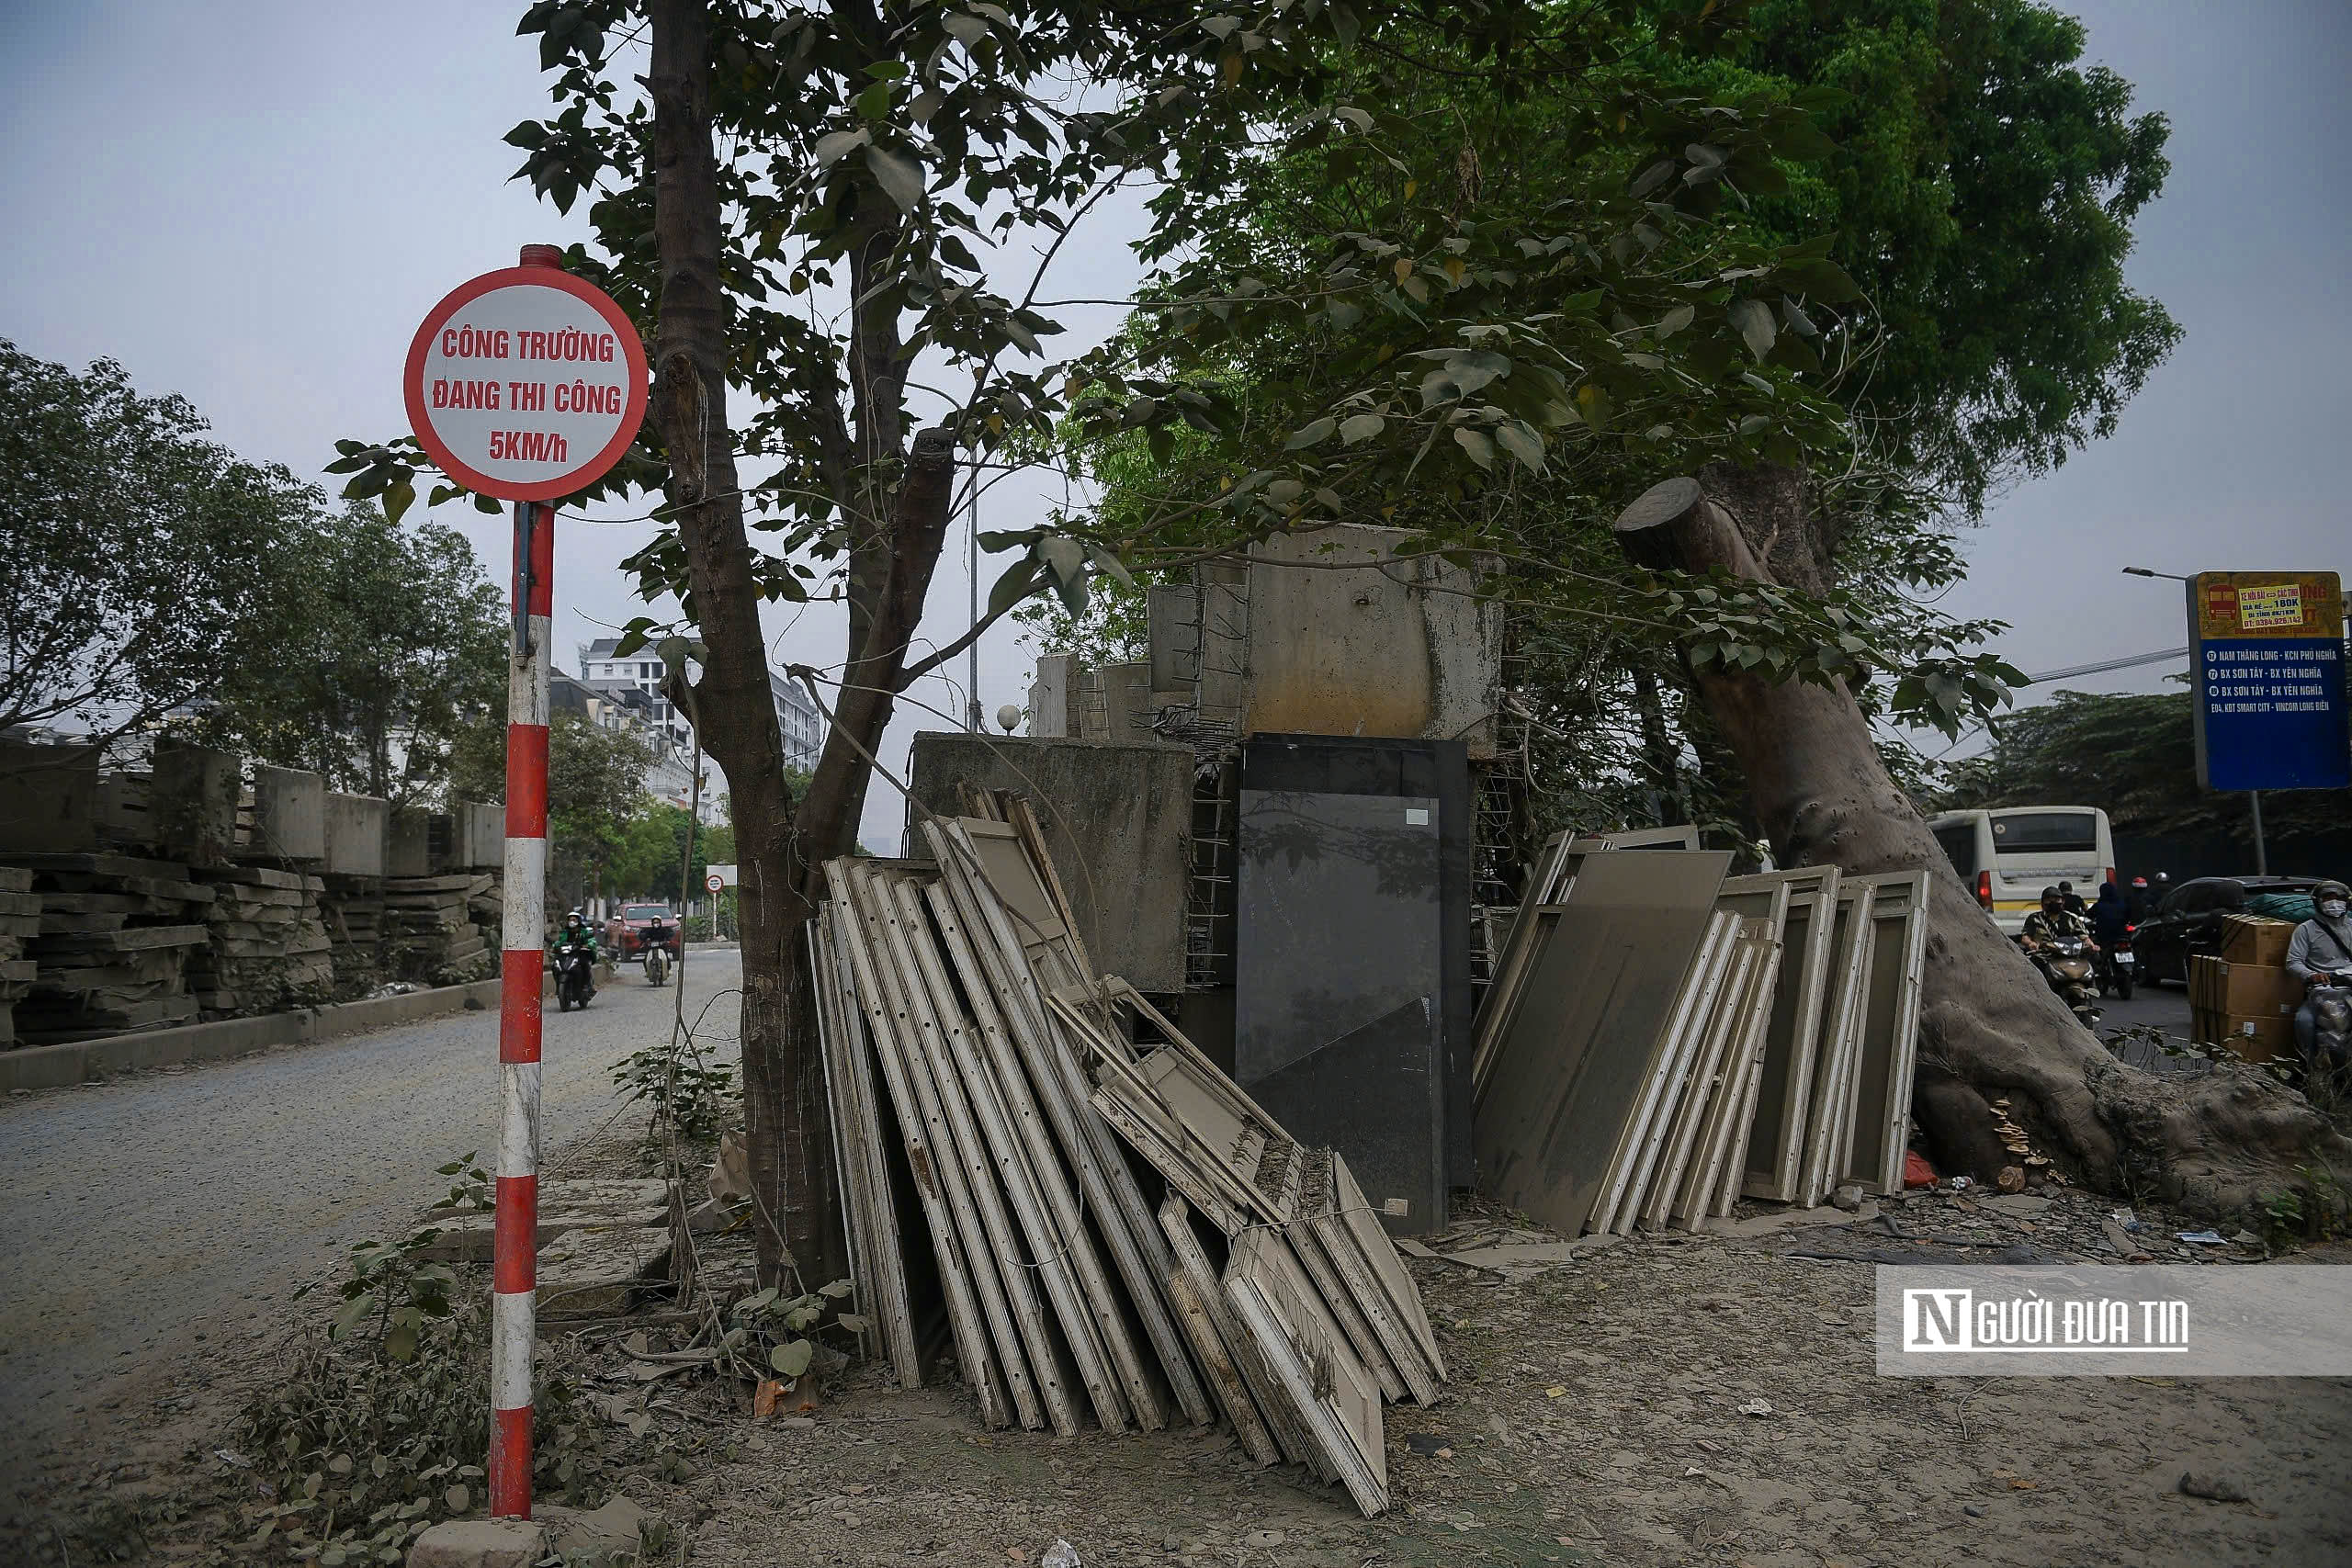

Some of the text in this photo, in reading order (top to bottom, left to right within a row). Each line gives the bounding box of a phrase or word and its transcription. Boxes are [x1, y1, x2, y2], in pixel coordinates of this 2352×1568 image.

[441, 323, 614, 363] CÔNG TRƯỜNG
[432, 378, 621, 415] ĐANG THI CÔNG
[489, 431, 568, 463] 5KM/h
[2274, 598, 2299, 608] 180K
[2219, 650, 2235, 661] NAM
[2260, 650, 2278, 660] LONG
[2284, 650, 2299, 660] KCN
[2315, 649, 2336, 660] NGHĨA
[2220, 669, 2231, 679] BX
[2270, 668, 2280, 679] BX
[2282, 666, 2297, 679] YÊN
[2299, 666, 2322, 679] NGHĨA
[2222, 686, 2232, 696] BX
[2271, 685, 2281, 696] BX
[2283, 683, 2298, 696] YÊN
[2300, 683, 2323, 696] NGHĨA
[2236, 703, 2256, 713] SMART
[2257, 702, 2270, 712] CITY
[2275, 702, 2299, 712] VINCOM
[2299, 701, 2315, 711] LONG
